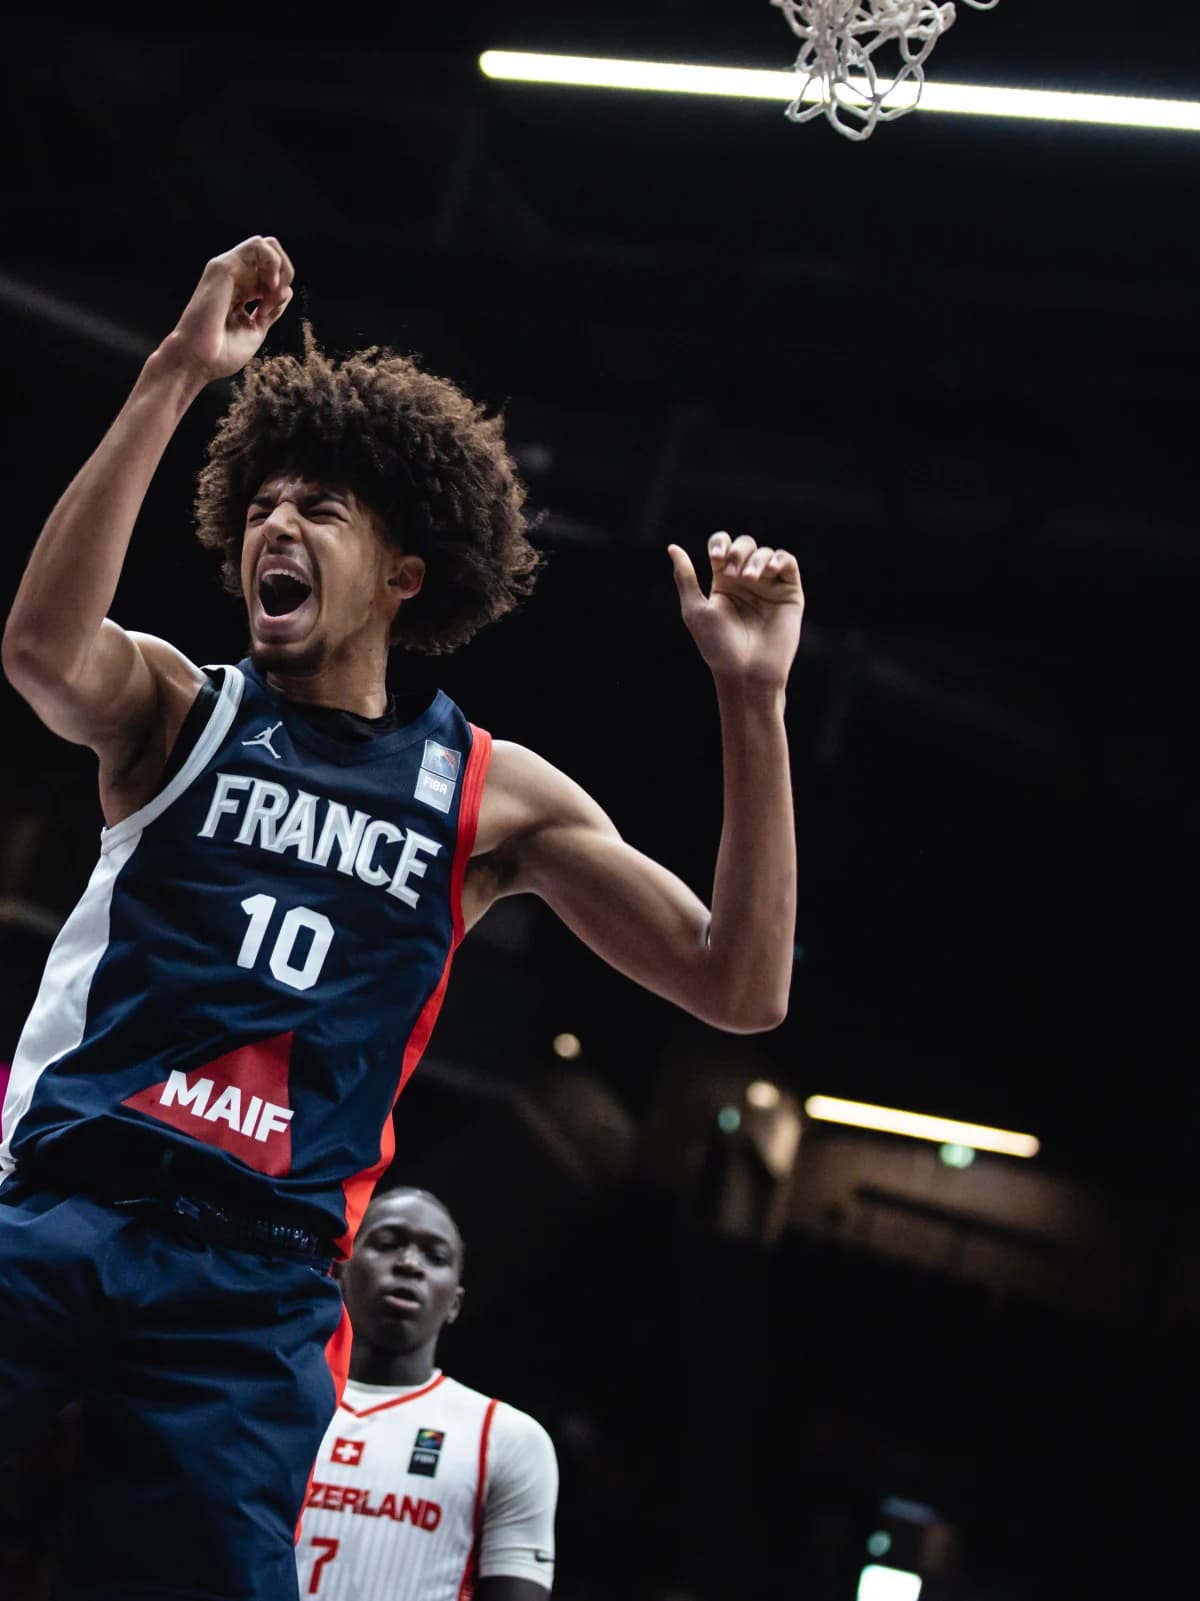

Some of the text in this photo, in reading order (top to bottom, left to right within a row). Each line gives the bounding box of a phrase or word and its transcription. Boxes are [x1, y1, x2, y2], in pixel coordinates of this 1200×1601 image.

[423, 776, 448, 795] FIBA
[197, 773, 443, 909] FRANCE
[236, 893, 335, 991] 10
[159, 1069, 294, 1143] MAIF
[308, 1536, 340, 1595] 7
